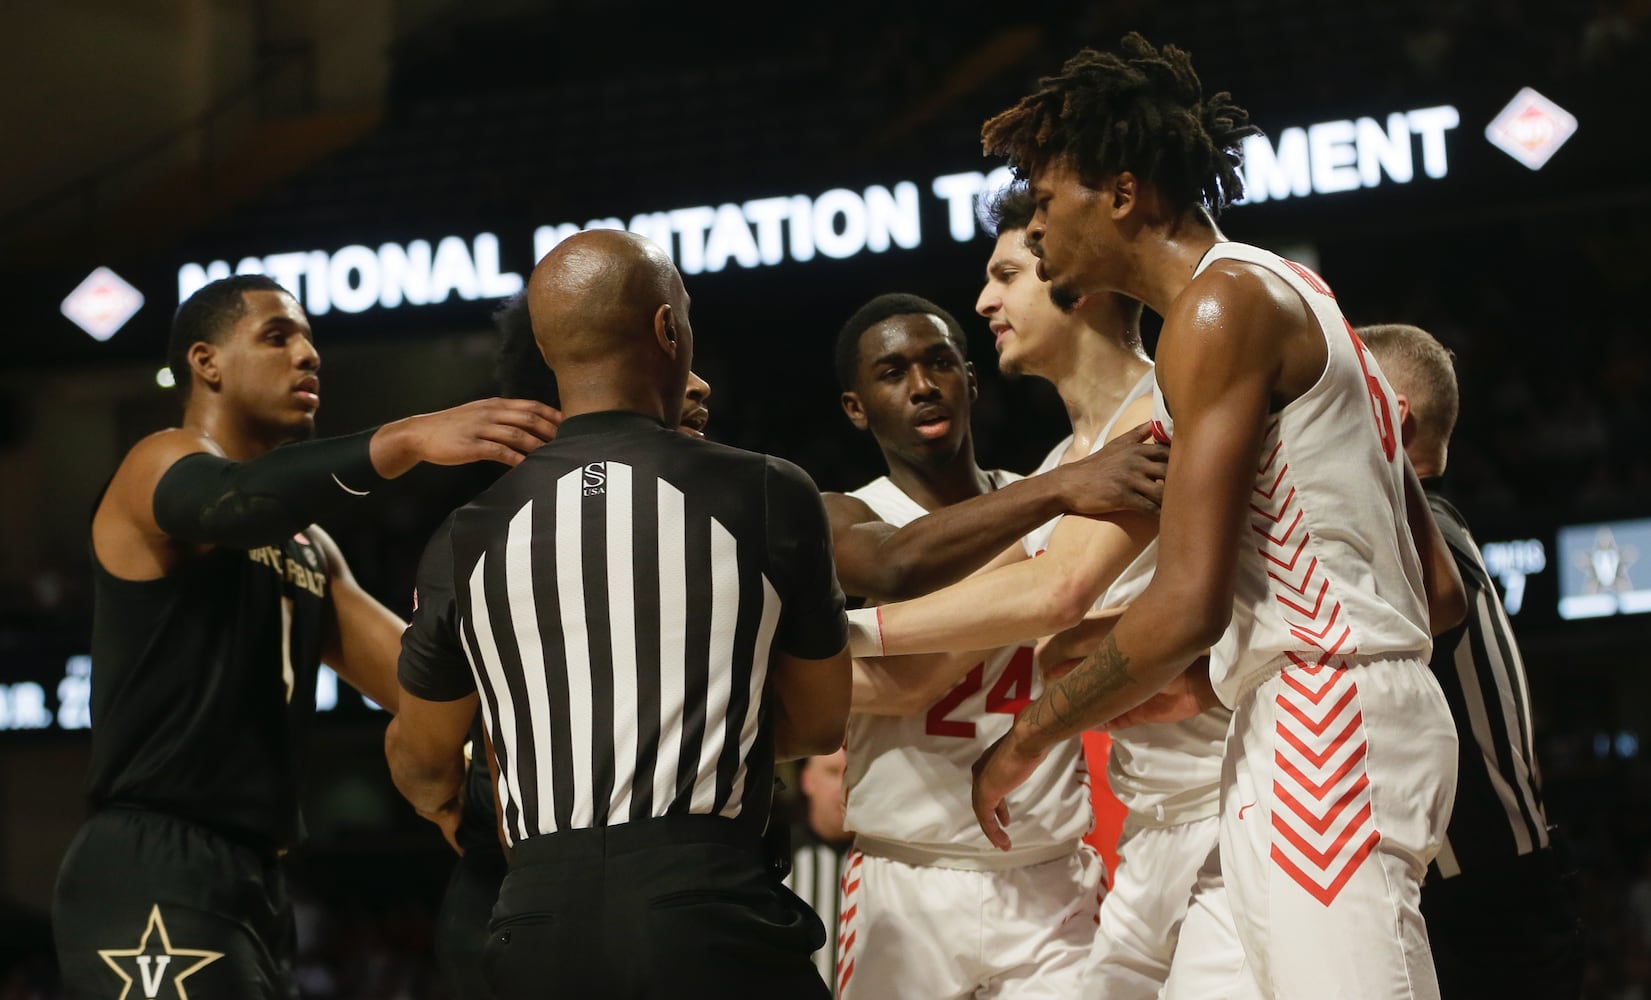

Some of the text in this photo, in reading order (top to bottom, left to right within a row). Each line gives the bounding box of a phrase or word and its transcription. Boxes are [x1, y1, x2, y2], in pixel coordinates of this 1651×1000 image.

[583, 487, 605, 497] USA
[925, 645, 1035, 738] 24
[136, 955, 171, 998] V
